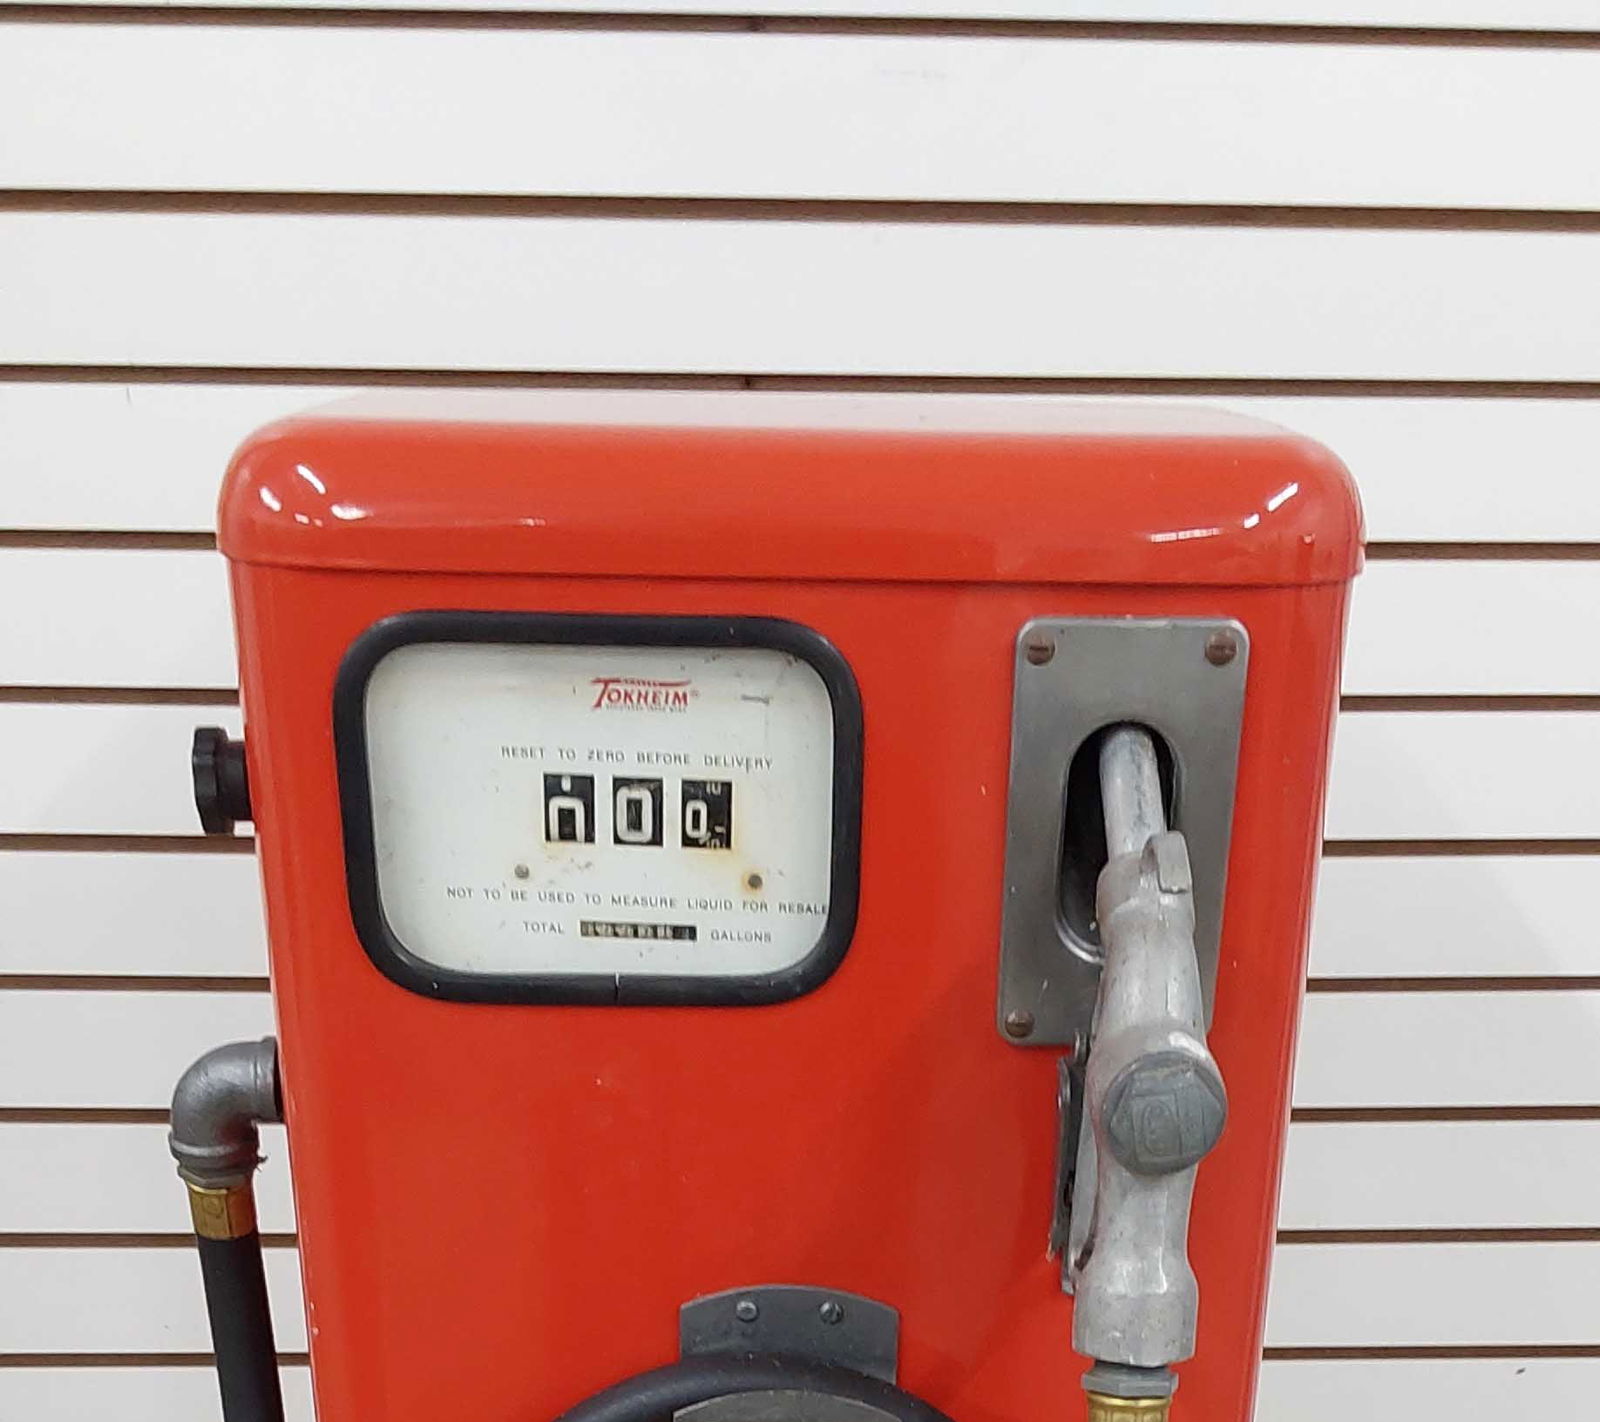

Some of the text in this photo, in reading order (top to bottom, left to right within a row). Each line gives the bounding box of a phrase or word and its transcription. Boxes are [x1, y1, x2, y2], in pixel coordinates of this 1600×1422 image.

[591, 678, 689, 708] TOKHEIM
[501, 745, 773, 771] RESET TO ZERO BEFORE DELIVERY
[616, 785, 653, 842] 0
[447, 887, 828, 916] NOT TO BE USED TO MEASURE LIQUID FOR RESALE
[523, 920, 565, 935] TOTAL
[710, 928, 772, 943] GALLONS
